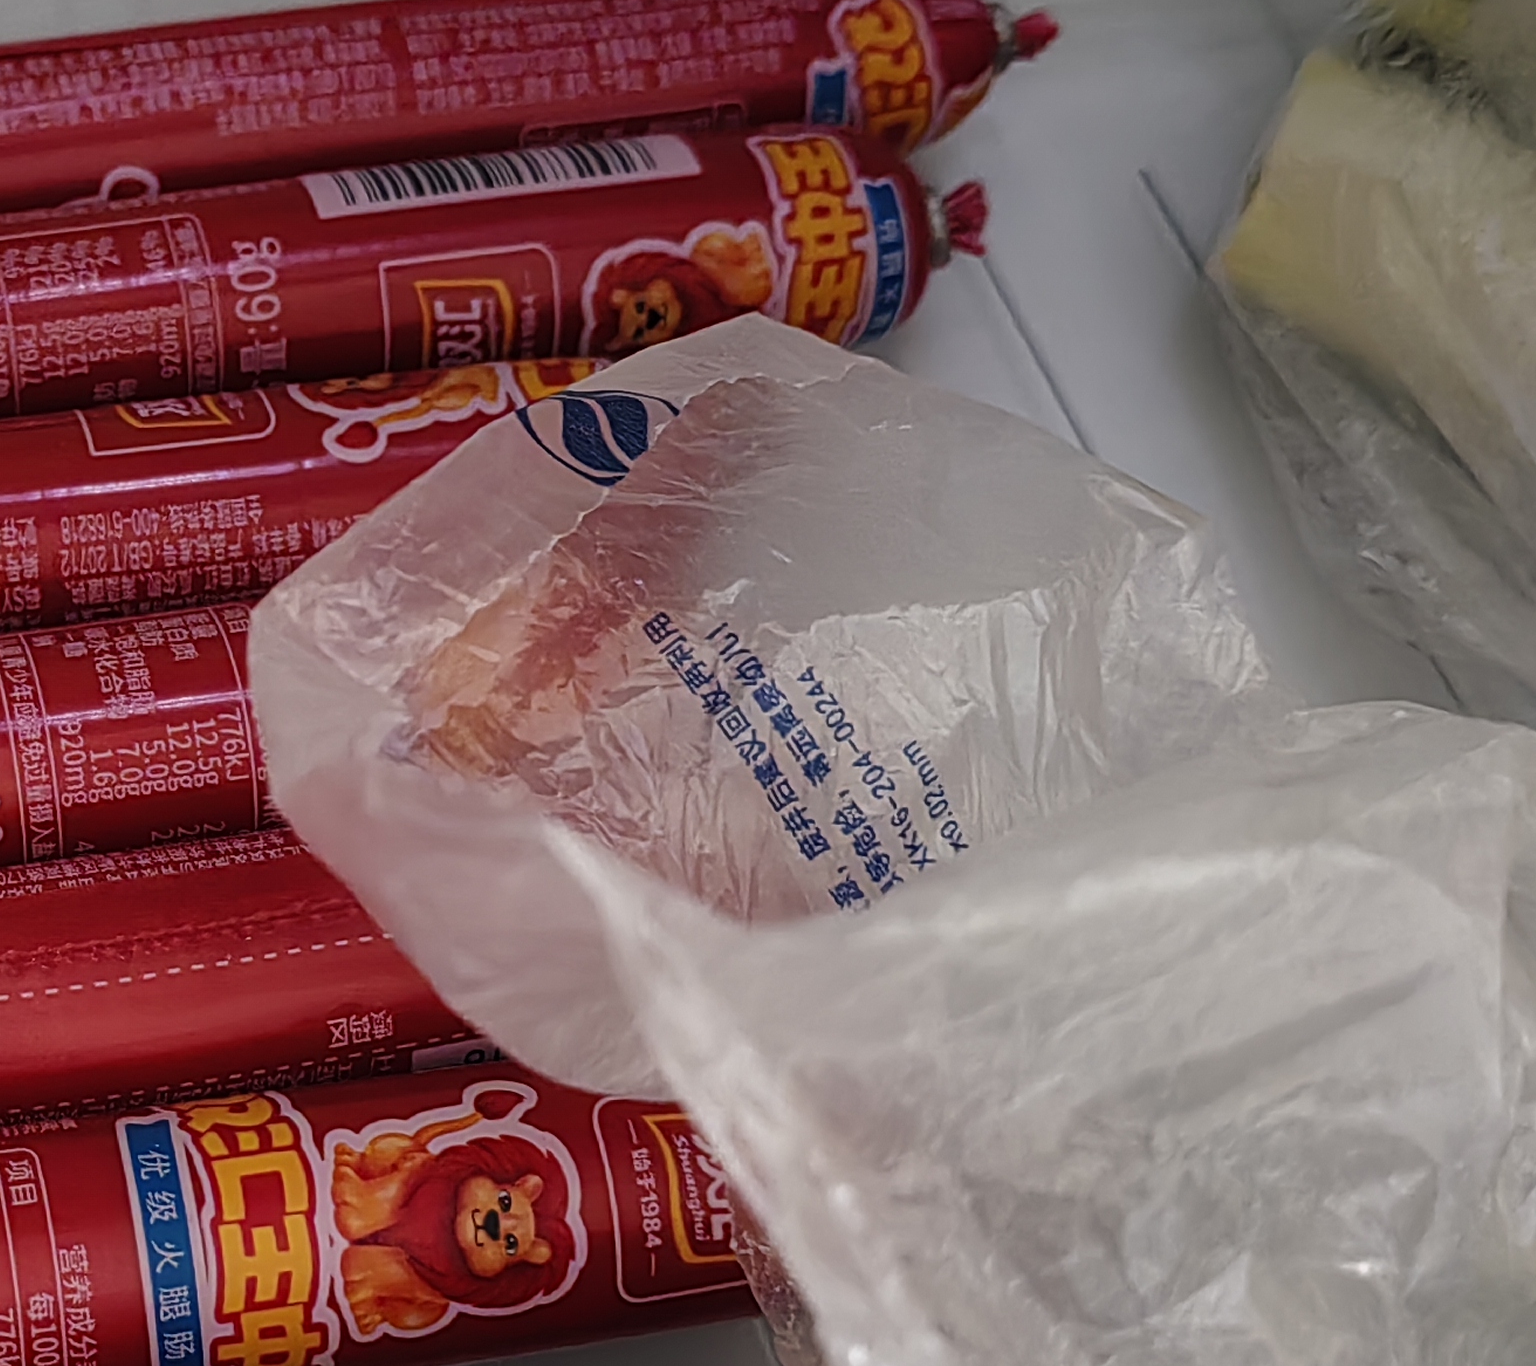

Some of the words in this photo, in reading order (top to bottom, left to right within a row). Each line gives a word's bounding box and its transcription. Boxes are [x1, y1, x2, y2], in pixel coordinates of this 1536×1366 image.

[113, 742, 143, 800] 7.0g
[140, 739, 170, 795] 5.0g
[166, 722, 196, 791] 12.0g
[191, 718, 222, 788] 12.5g
[217, 706, 250, 781] 776kJ
[89, 749, 115, 803] 1.6g
[6, 1159, 38, 1207] 项目
[135, 1146, 197, 1362] 优级火腿肠
